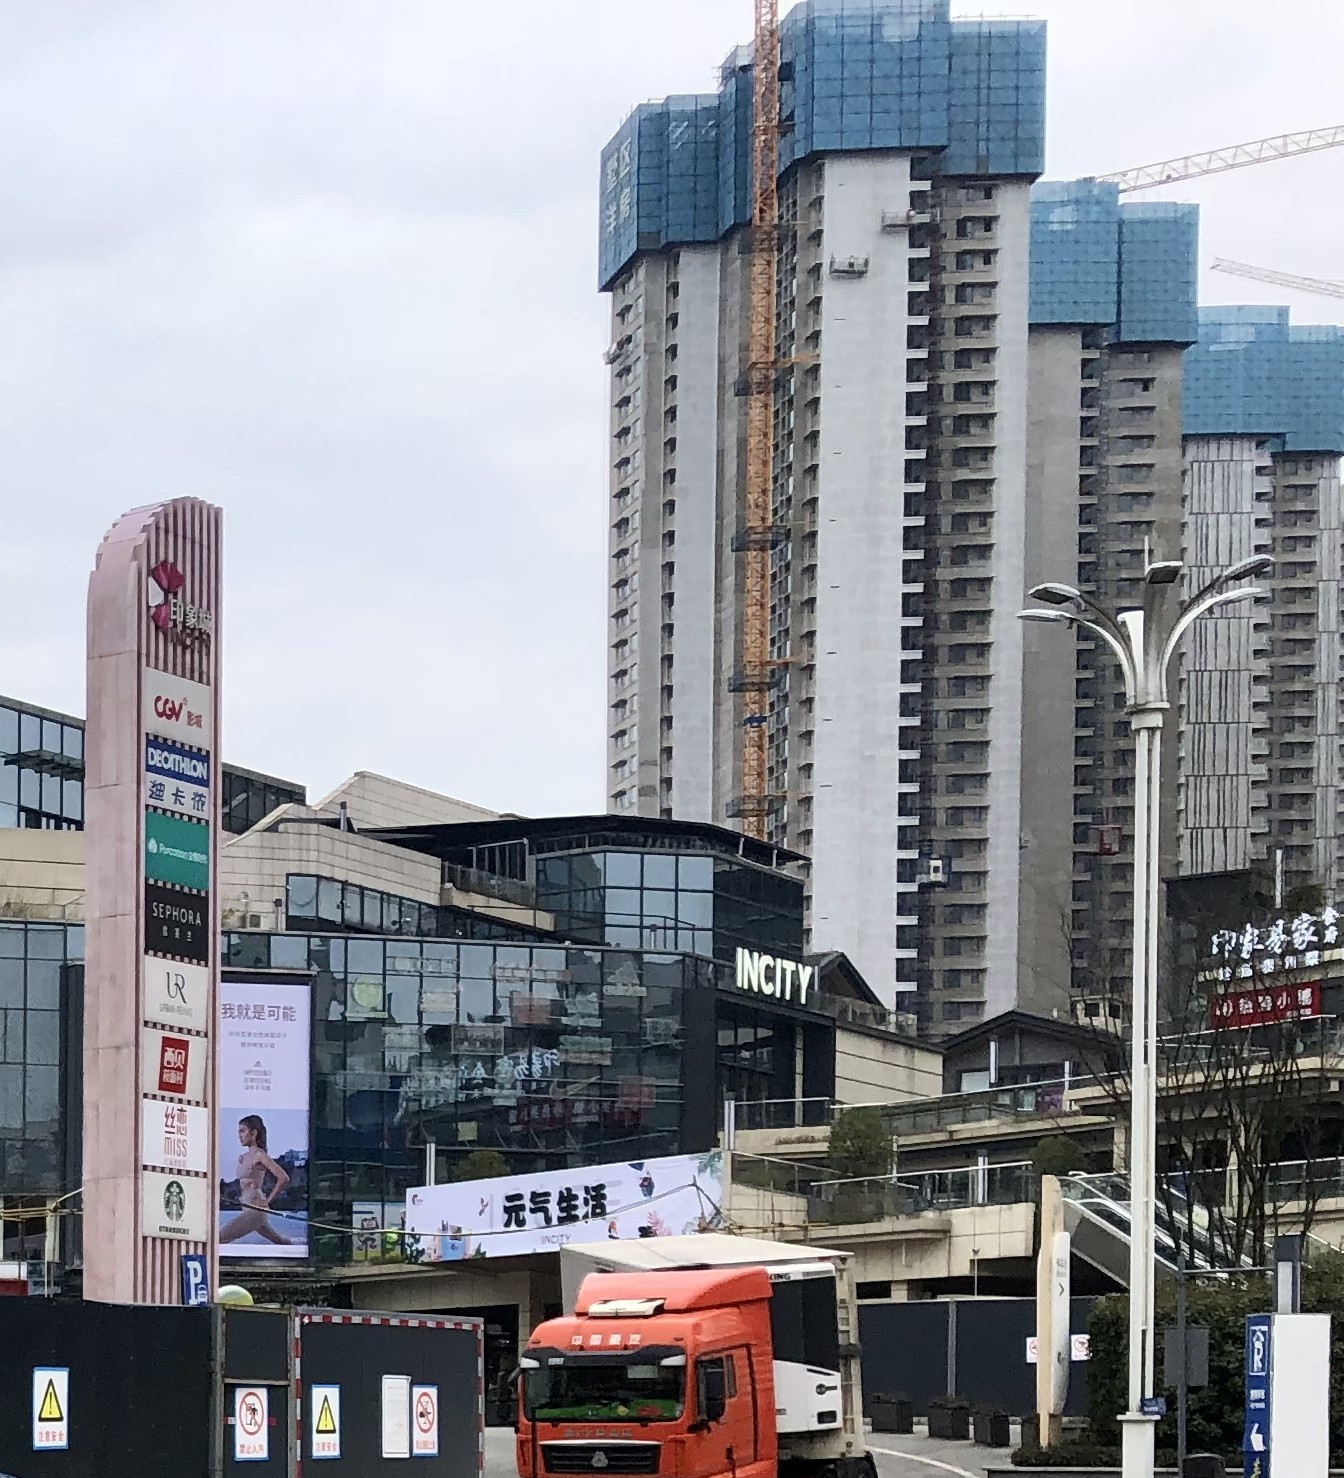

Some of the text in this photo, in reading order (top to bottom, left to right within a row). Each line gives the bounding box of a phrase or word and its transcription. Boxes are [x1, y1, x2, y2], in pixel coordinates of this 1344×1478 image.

[170, 598, 211, 633] 印象城
[154, 695, 183, 722] CGV
[147, 746, 208, 780] DECATHLON
[148, 779, 207, 813] 迪卡侬
[152, 901, 202, 927] SEPHORA
[165, 971, 188, 1005] UR
[736, 947, 813, 1005] INCITY
[221, 1003, 297, 1022] 我就是可能
[503, 1183, 607, 1228] 元气生活
[541, 1234, 571, 1245] INCITY
[37, 1430, 64, 1443] 注意安全
